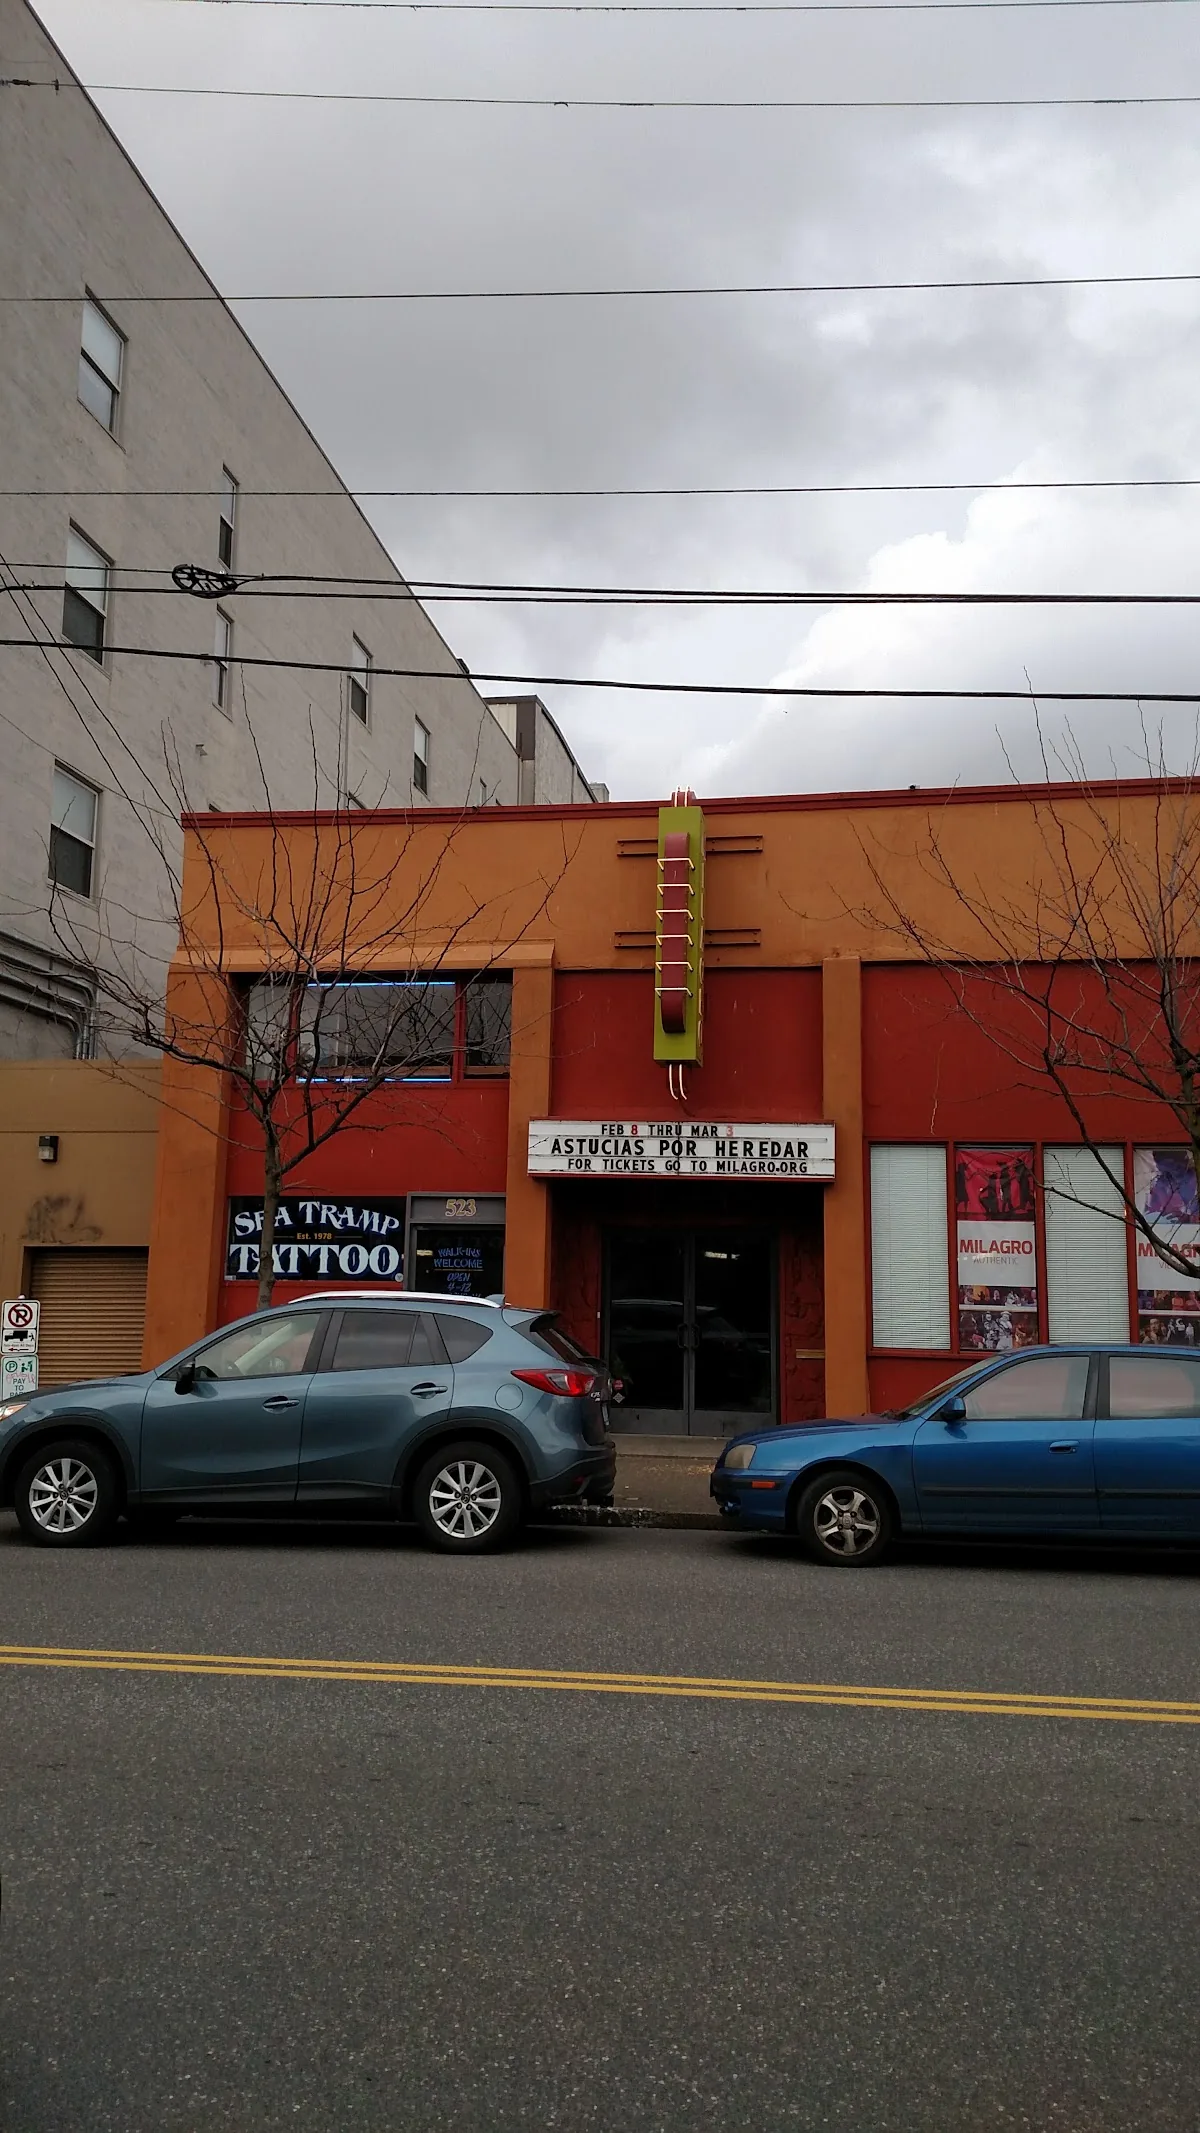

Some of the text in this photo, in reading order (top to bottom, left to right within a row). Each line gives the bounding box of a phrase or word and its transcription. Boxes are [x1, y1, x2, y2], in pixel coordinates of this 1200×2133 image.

[601, 1124, 734, 1137] FEB 8 THRU MAR 3
[551, 1138, 809, 1158] ASTUCIAS POR HEREDAR
[568, 1158, 808, 1173] FOR TICKETS GO TO MILAGRO.ORG
[445, 1199, 477, 1217] 523
[299, 1201, 400, 1235] TRAMP
[296, 1232, 333, 1240] Est. 1978
[959, 1239, 1033, 1255] MILAGRO
[433, 1258, 483, 1269] WELCOME
[447, 1272, 471, 1282] OPEN
